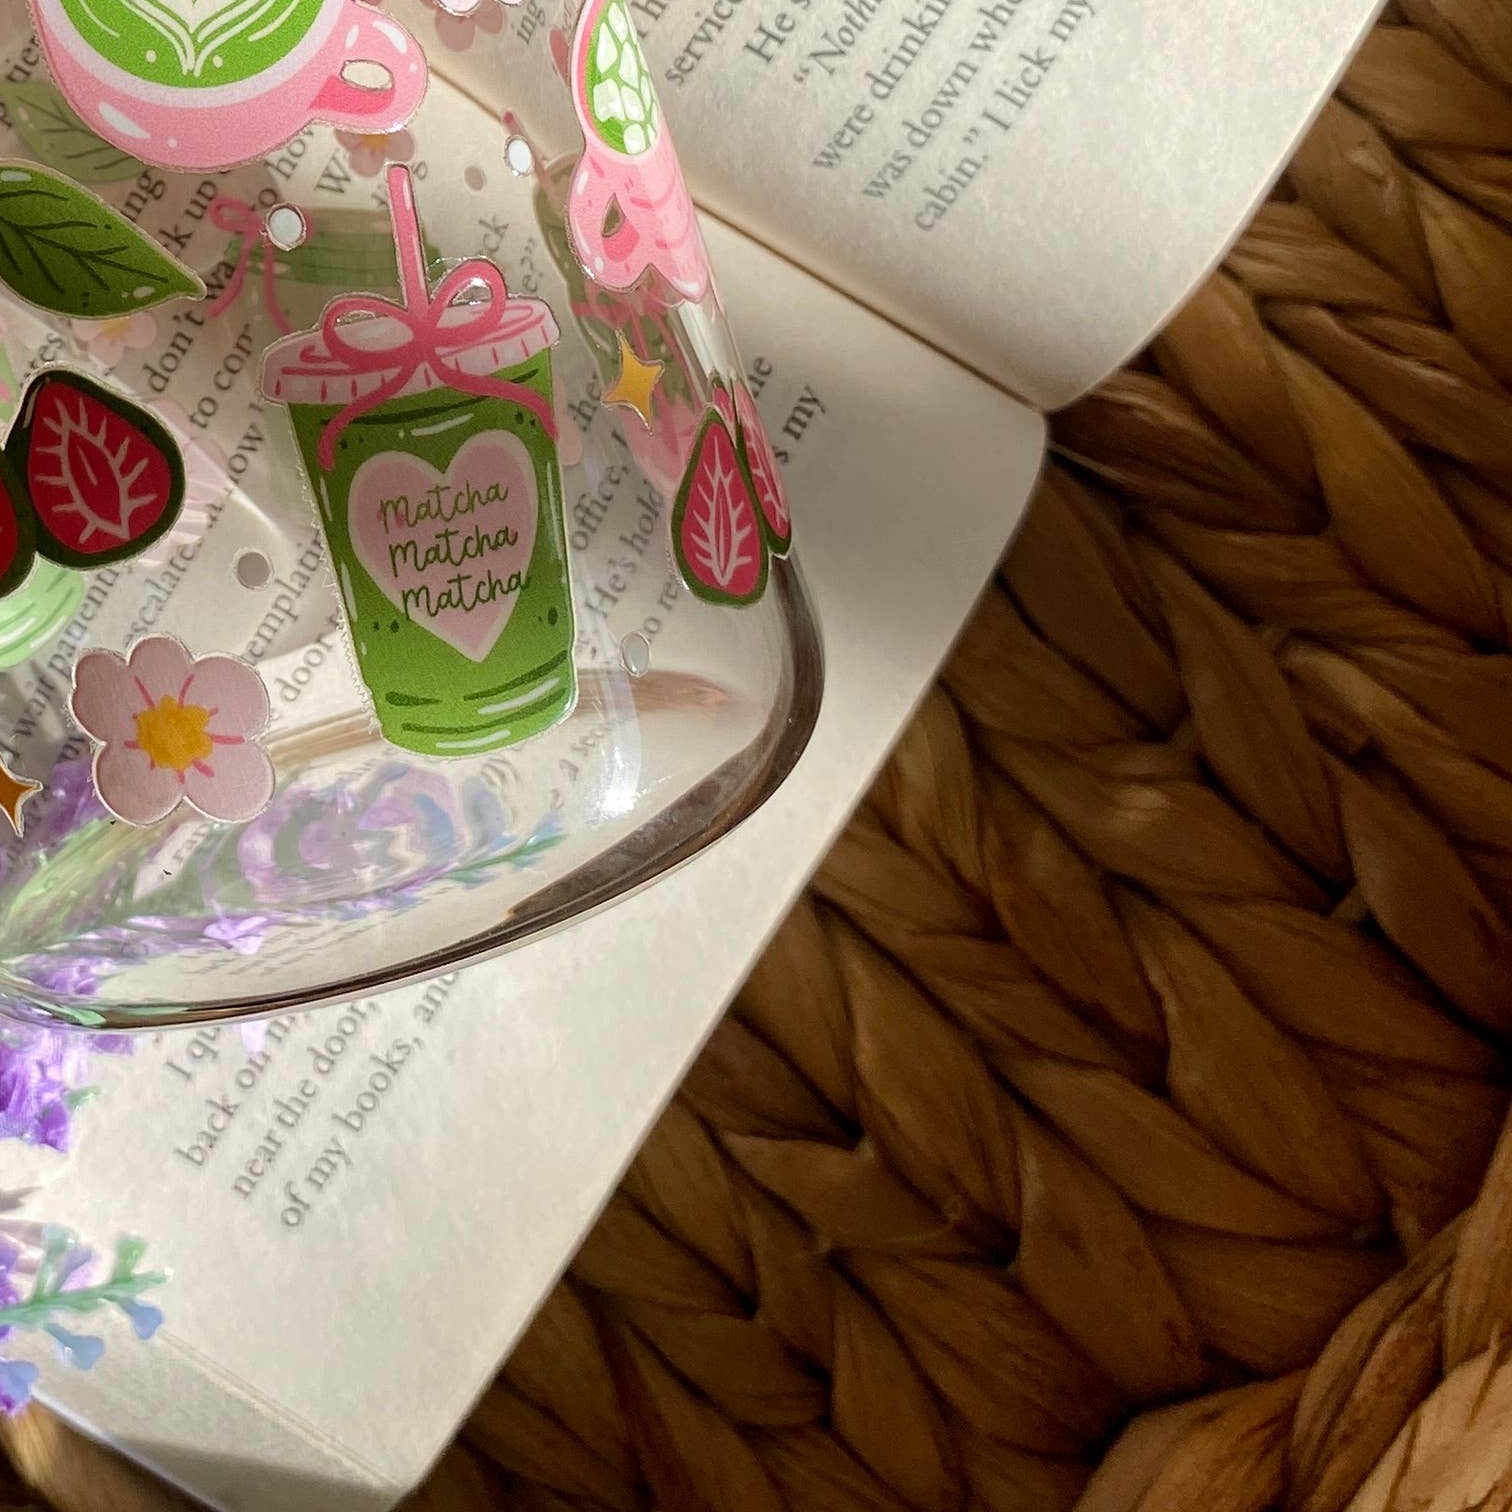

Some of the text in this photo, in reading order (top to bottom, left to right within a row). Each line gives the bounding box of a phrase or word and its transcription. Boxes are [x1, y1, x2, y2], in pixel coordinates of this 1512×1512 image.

[742, 12, 796, 64] He
[993, 46, 1057, 110] lick
[980, 108, 1011, 131] I
[914, 127, 989, 231] cabin.”
[187, 395, 219, 429] to
[781, 385, 826, 441] my
[379, 480, 509, 534] Matcha
[389, 525, 519, 578] Matcha
[401, 570, 530, 621] Matcha
[230, 994, 378, 1200] near the door,
[279, 1036, 424, 1228] of my books,
